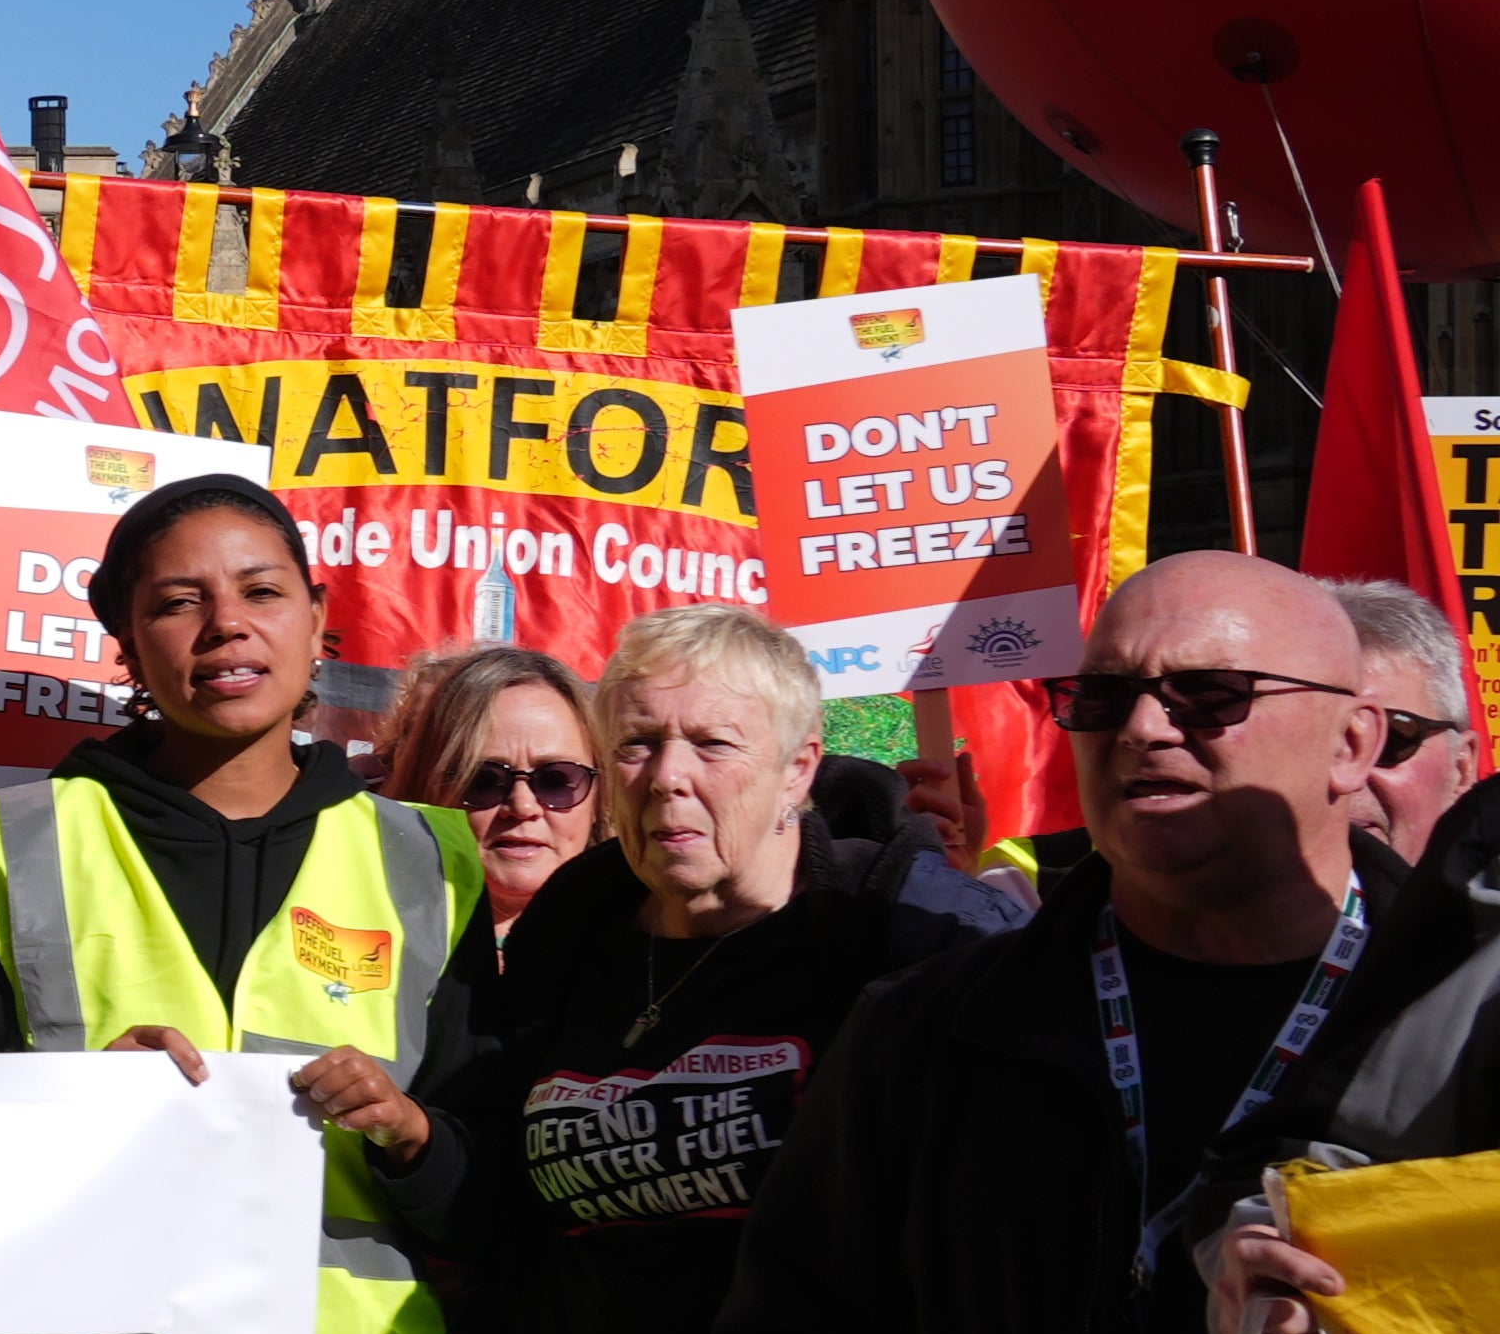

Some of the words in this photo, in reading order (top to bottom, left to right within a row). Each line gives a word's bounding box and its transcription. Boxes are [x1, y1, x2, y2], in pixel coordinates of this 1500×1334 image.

[139, 370, 756, 517] WATFOR
[803, 404, 998, 464] DON'T
[804, 472, 914, 520] LET
[931, 460, 1012, 504] US
[297, 507, 393, 567] ade
[411, 508, 574, 579] Union
[592, 522, 768, 606] Counc
[799, 515, 1031, 578] FREEZE
[5, 612, 108, 663] LET
[808, 644, 881, 675] NPC
[296, 912, 334, 942] DEFEND
[298, 929, 318, 950] THE
[320, 941, 344, 962] FUEL
[300, 947, 350, 980] PAYMENT
[663, 1048, 788, 1074] MEMBERS
[525, 1099, 656, 1161] DEFEND
[673, 1086, 753, 1129] THE
[529, 1141, 665, 1202] WINTER
[676, 1113, 783, 1167] FUEL
[569, 1162, 750, 1224] PAYMENT
